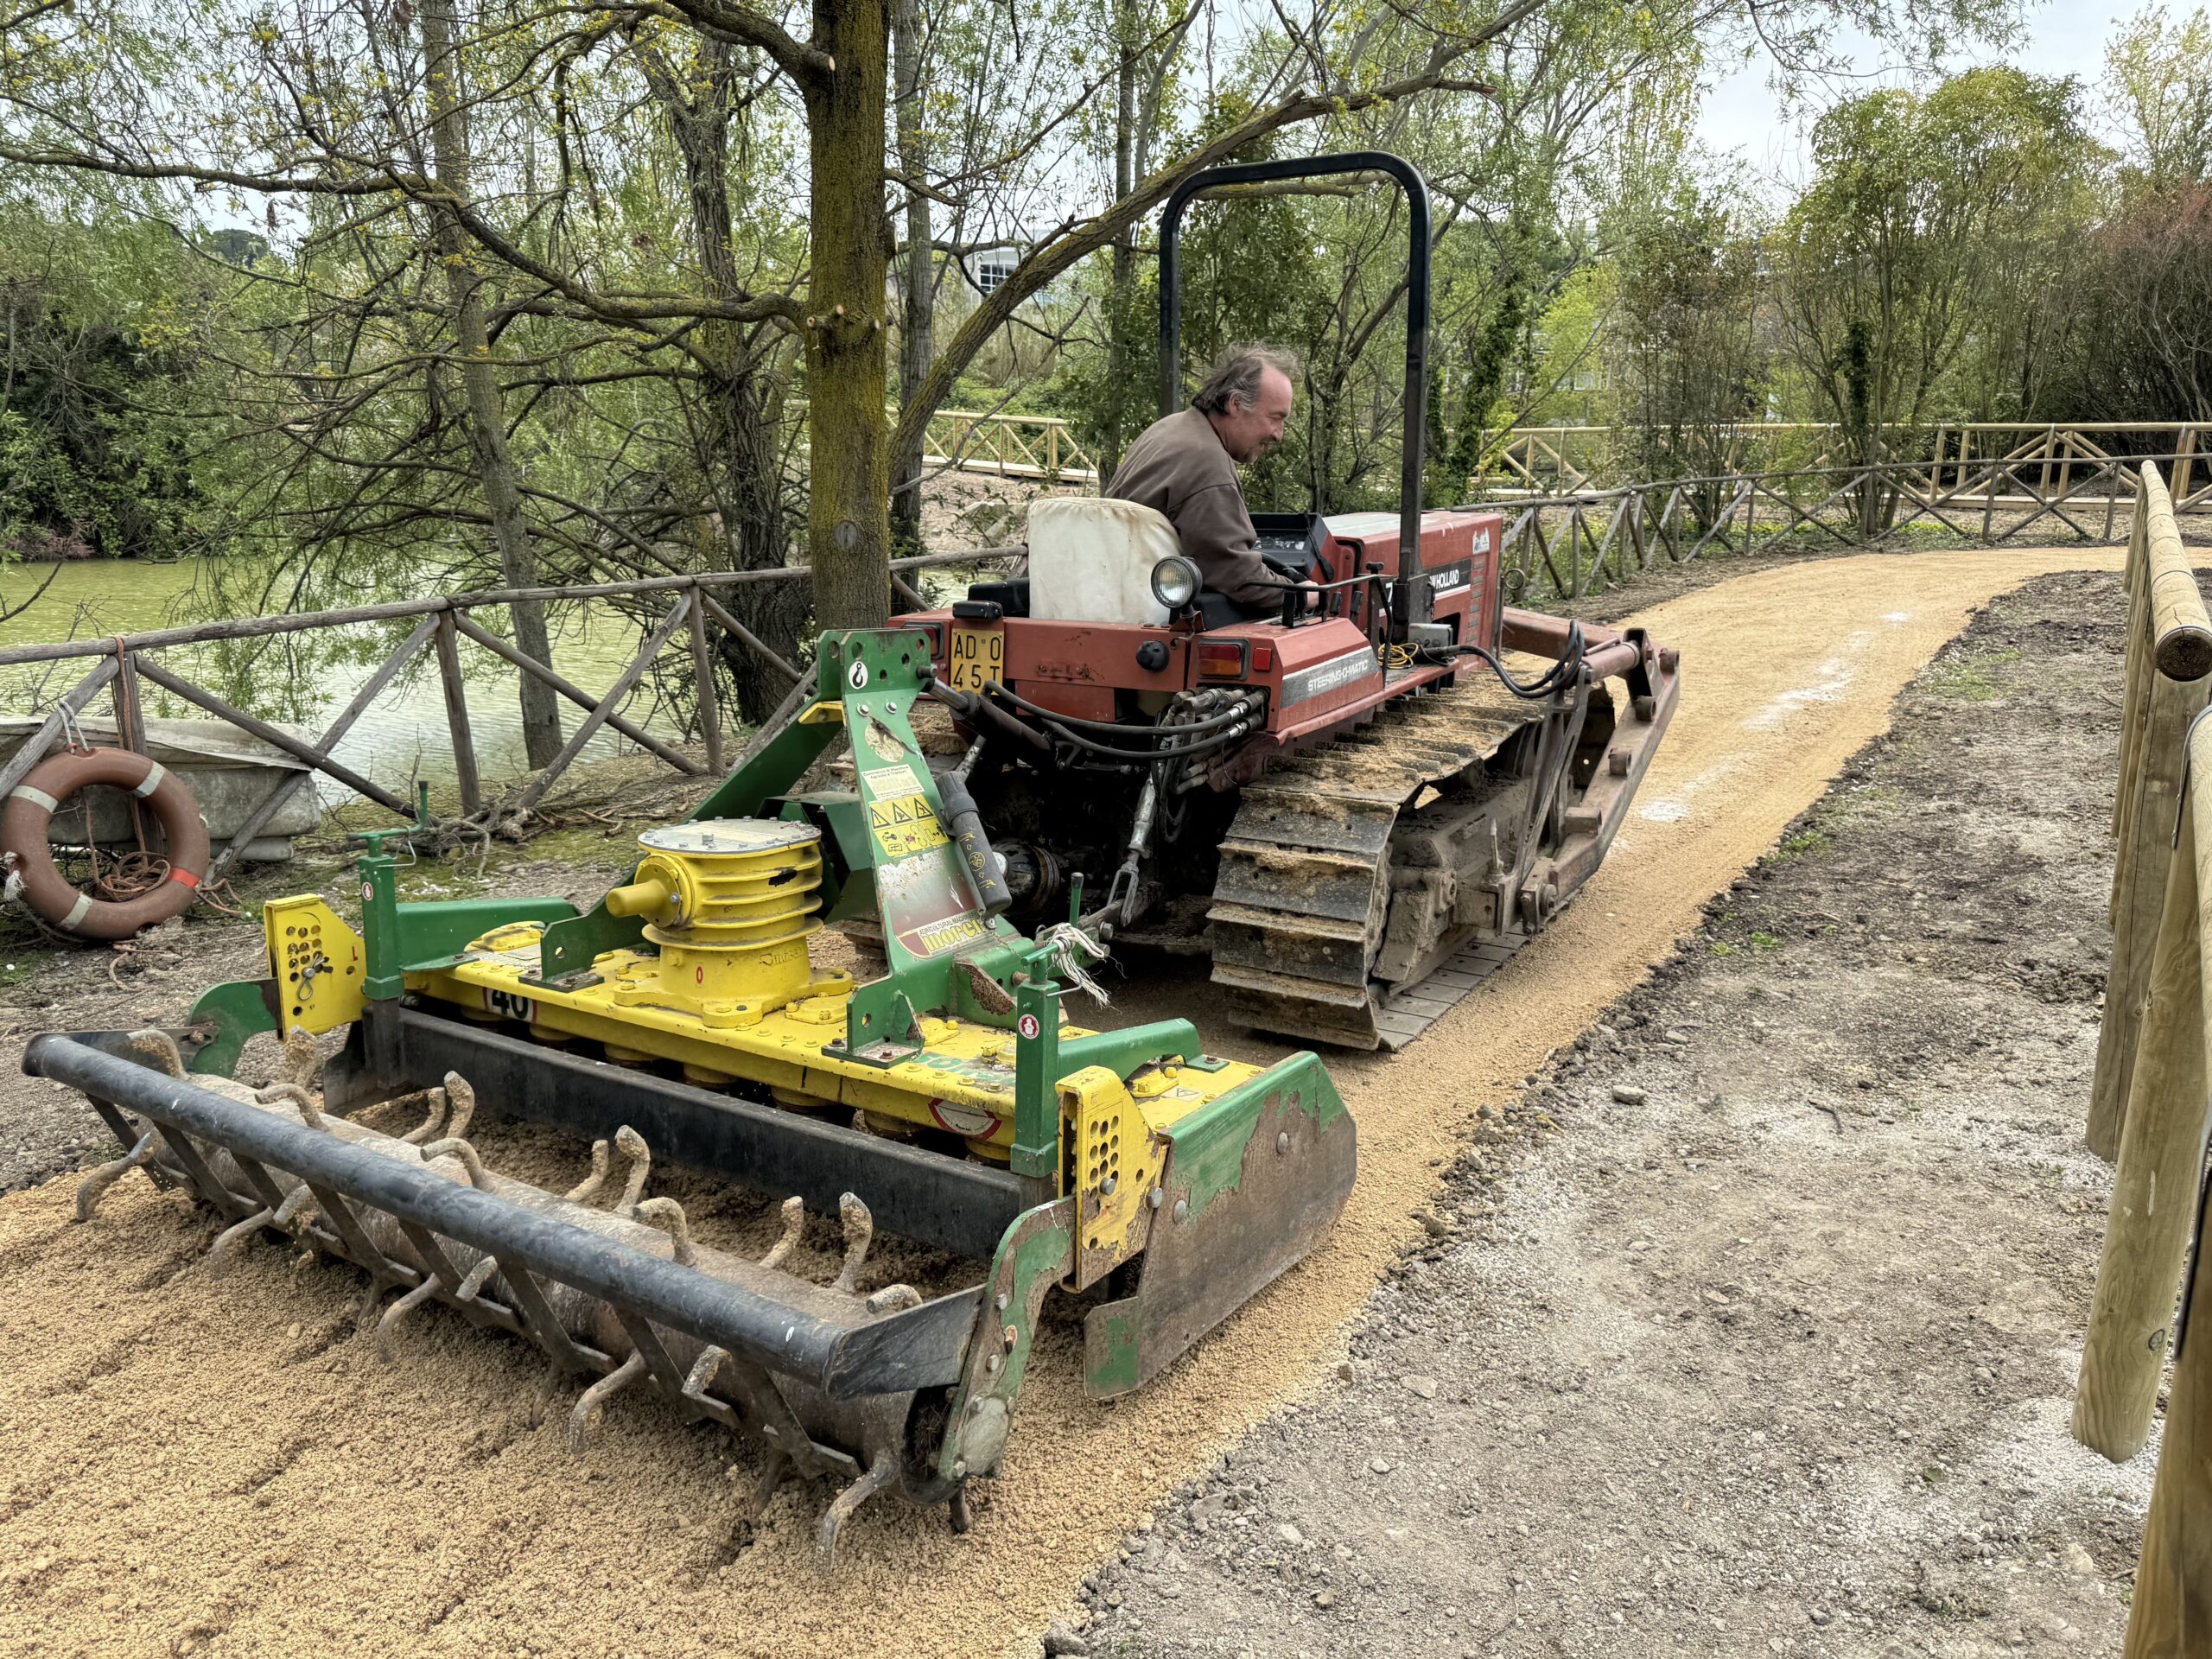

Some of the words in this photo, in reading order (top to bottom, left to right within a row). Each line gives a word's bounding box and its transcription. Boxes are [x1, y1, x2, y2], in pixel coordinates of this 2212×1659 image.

[1435, 569, 1459, 589] HOLLAND
[954, 634, 976, 659] AD
[1307, 658, 1369, 692] STEERING-O-MATIC
